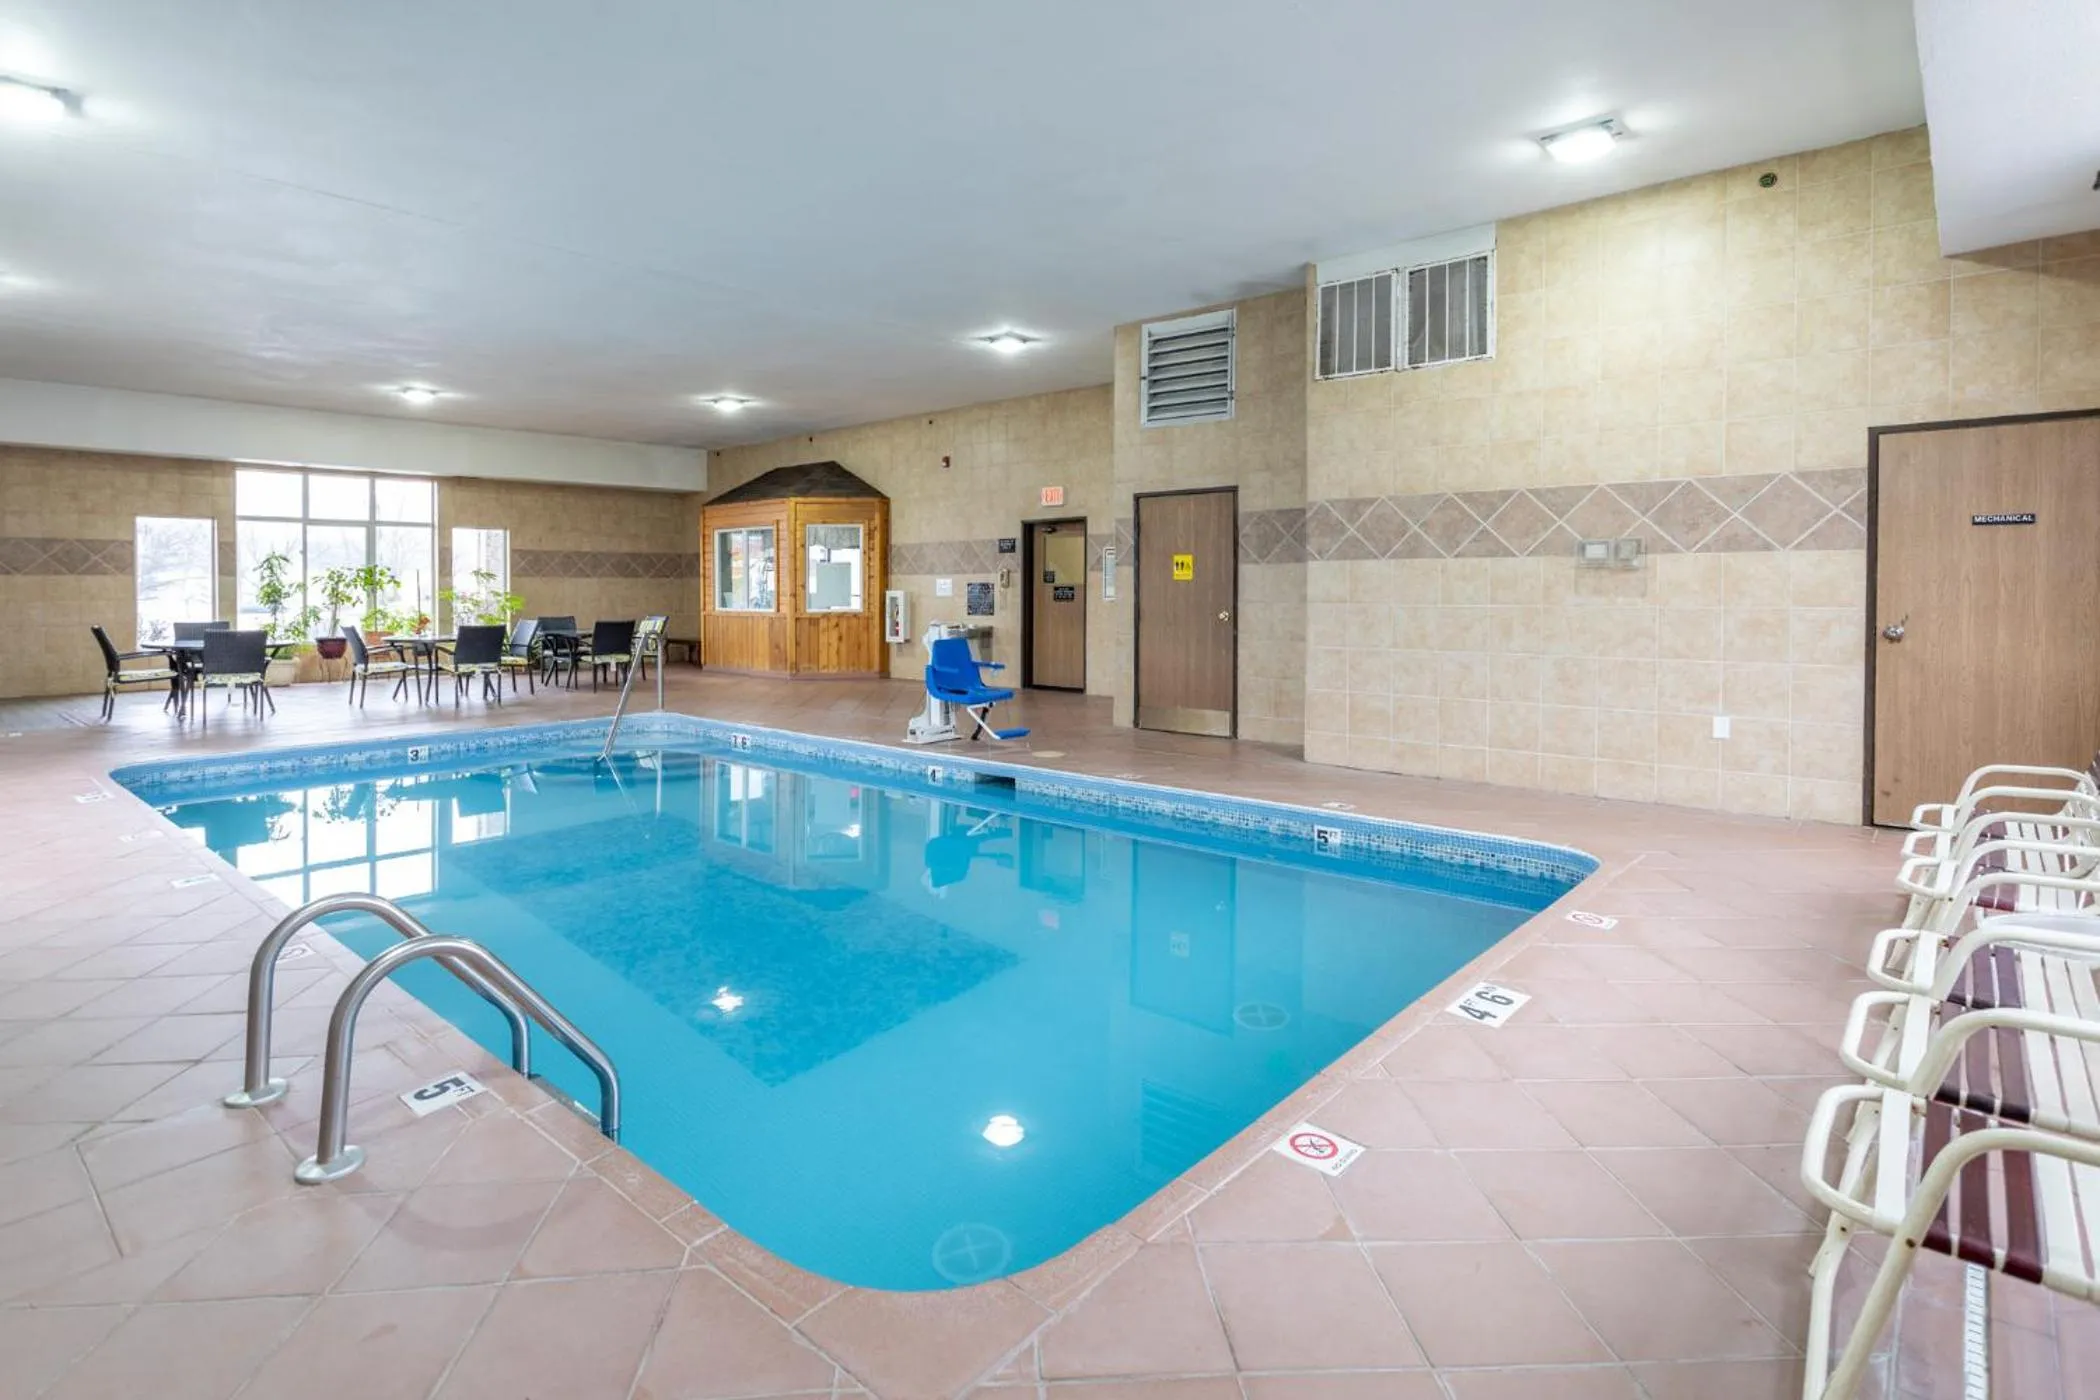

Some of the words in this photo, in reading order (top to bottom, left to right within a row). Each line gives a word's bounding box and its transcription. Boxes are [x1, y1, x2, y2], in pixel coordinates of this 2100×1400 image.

[1974, 514, 2033, 523] MECHANICAL
[410, 749, 419, 761] 3
[1317, 829, 1328, 845] 5
[1475, 991, 1514, 1006] 6
[1458, 1004, 1498, 1020] 4
[413, 1077, 466, 1101] 5
